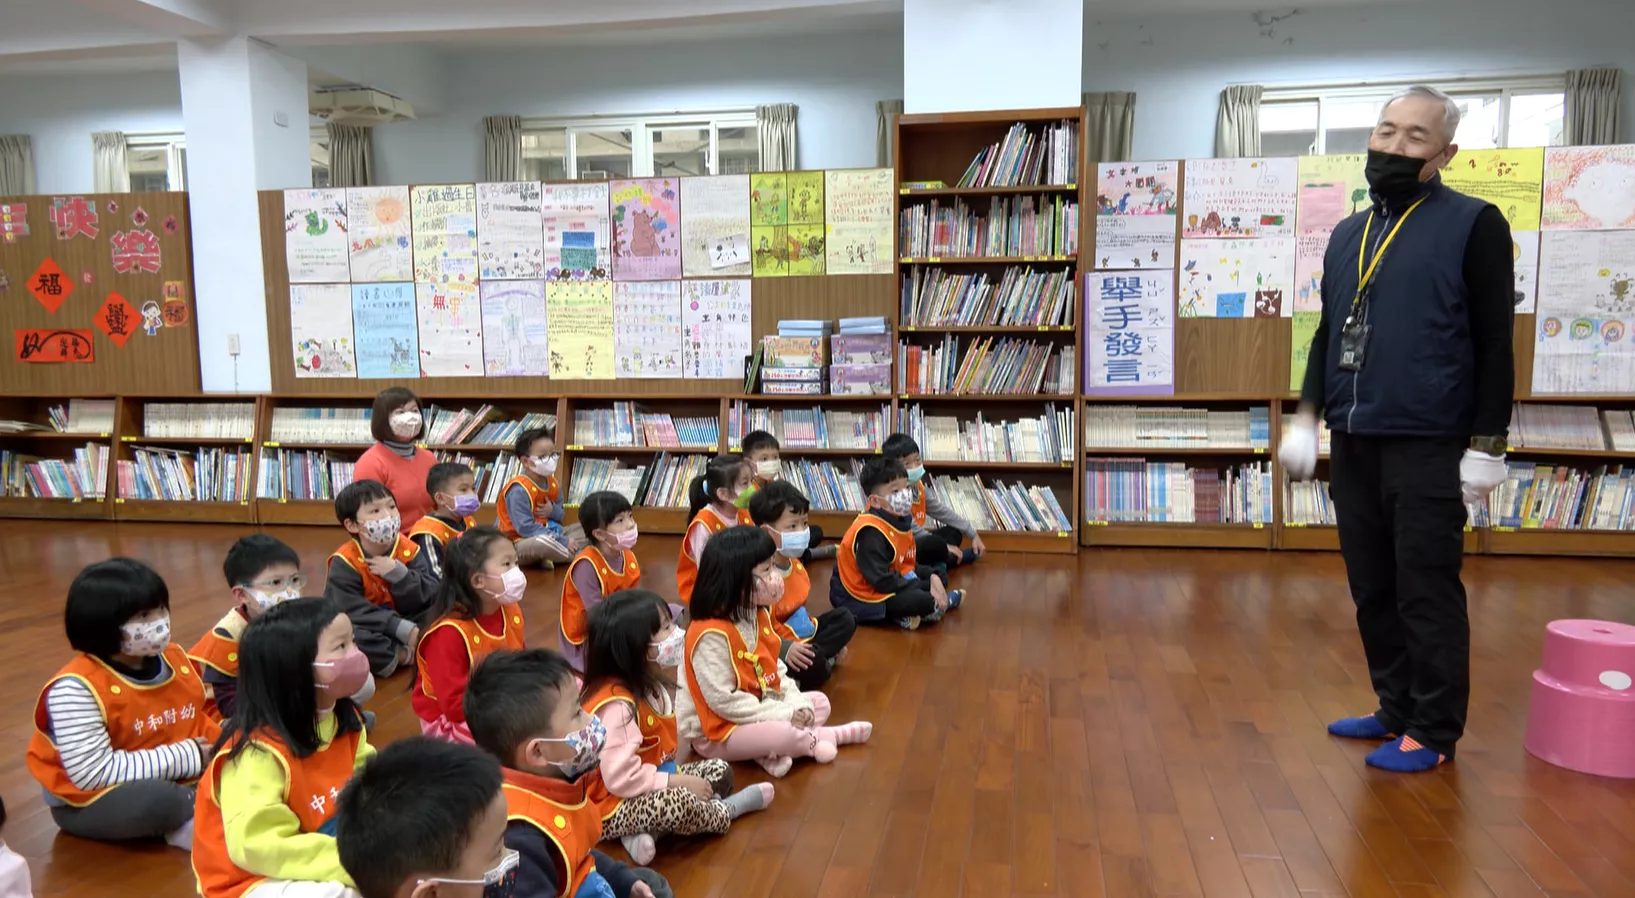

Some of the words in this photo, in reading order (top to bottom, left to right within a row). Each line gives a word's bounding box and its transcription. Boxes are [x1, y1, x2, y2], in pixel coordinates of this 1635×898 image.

[35, 273, 62, 295] 福
[1101, 276, 1143, 383] 舉手發言
[134, 702, 196, 736] 中和附幼
